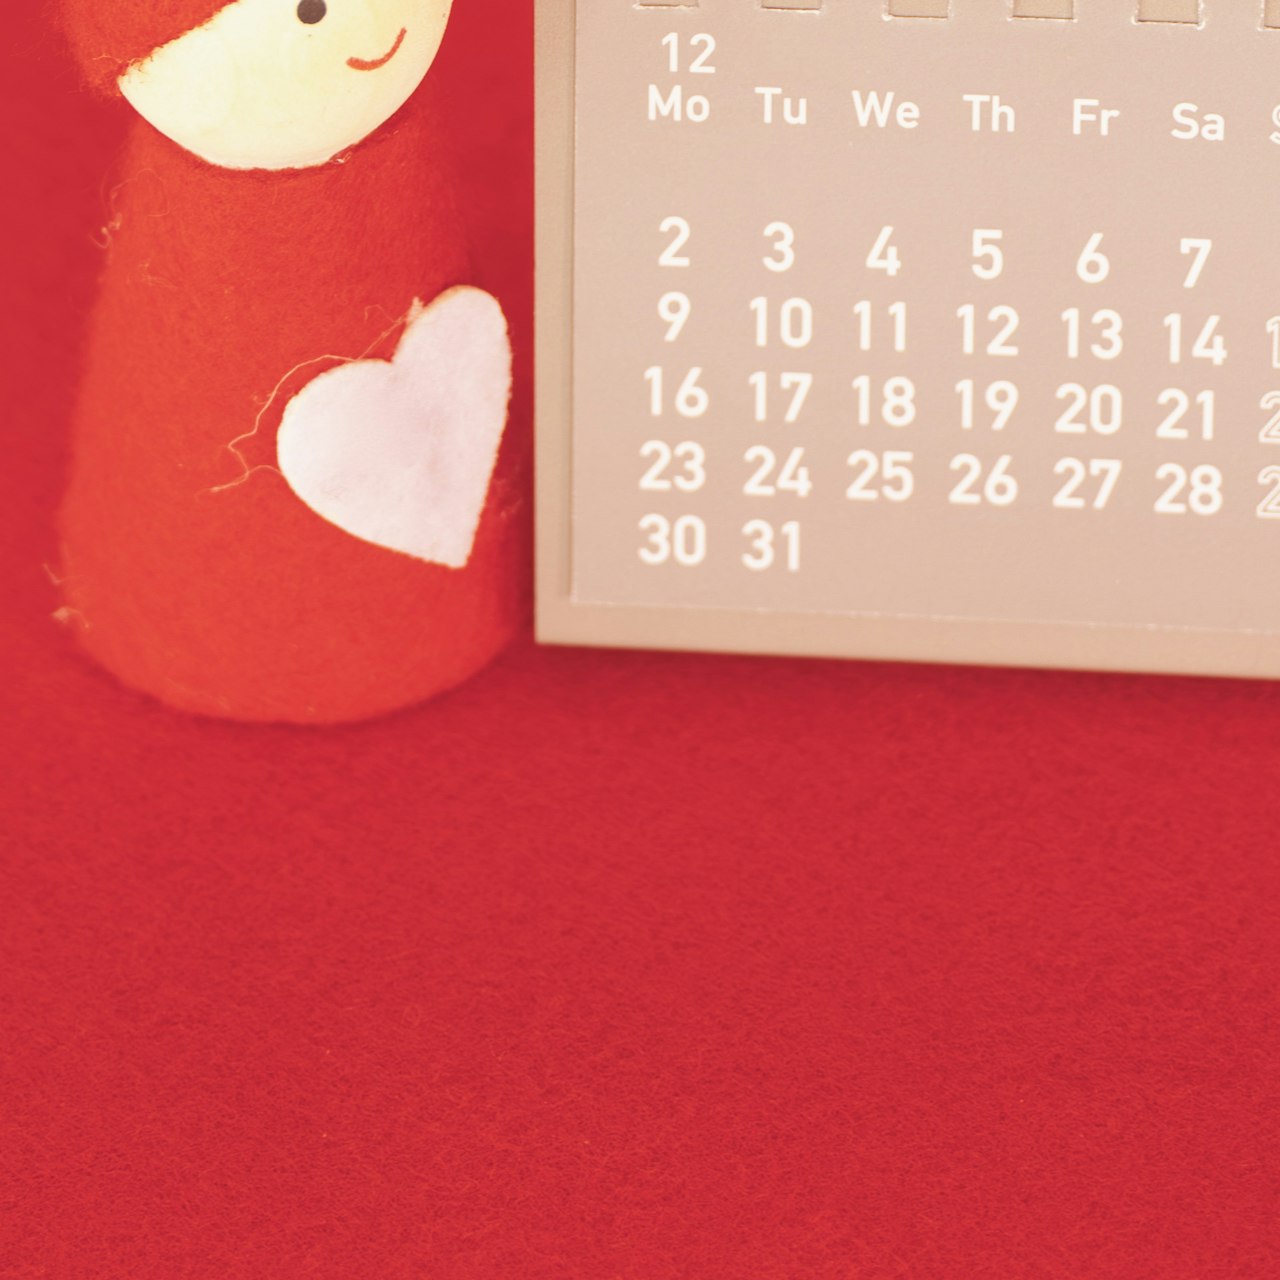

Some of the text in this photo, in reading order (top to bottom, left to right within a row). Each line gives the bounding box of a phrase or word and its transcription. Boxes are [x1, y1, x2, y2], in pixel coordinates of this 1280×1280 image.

[661, 32, 716, 74] 12
[648, 84, 710, 123] Mo
[754, 86, 807, 125] Tu
[851, 90, 920, 129] We
[962, 94, 1015, 133] Th
[1072, 98, 1120, 136] Fr
[1171, 102, 1225, 141] Sa
[658, 216, 690, 267] 2
[763, 221, 795, 272] 3
[866, 226, 901, 276] 4
[972, 229, 1003, 280] 5
[1076, 232, 1110, 283] 6
[1180, 238, 1212, 288] 7
[658, 291, 690, 342] 9
[750, 296, 812, 348] 10
[853, 300, 906, 351] 11
[957, 304, 1019, 356] 12
[1061, 307, 1123, 359] 13
[1163, 313, 1228, 365] 14
[644, 366, 709, 417] 16
[749, 371, 813, 422] 17
[852, 375, 916, 426] 18
[955, 379, 1018, 430] 19
[1055, 382, 1122, 434] 20
[1156, 388, 1214, 440] 21
[639, 440, 705, 491] 23
[743, 445, 811, 497] 24
[847, 449, 913, 501] 25
[949, 453, 1018, 505] 26
[1053, 457, 1121, 509] 27
[1155, 463, 1222, 515] 28
[639, 513, 800, 571] 30 31
